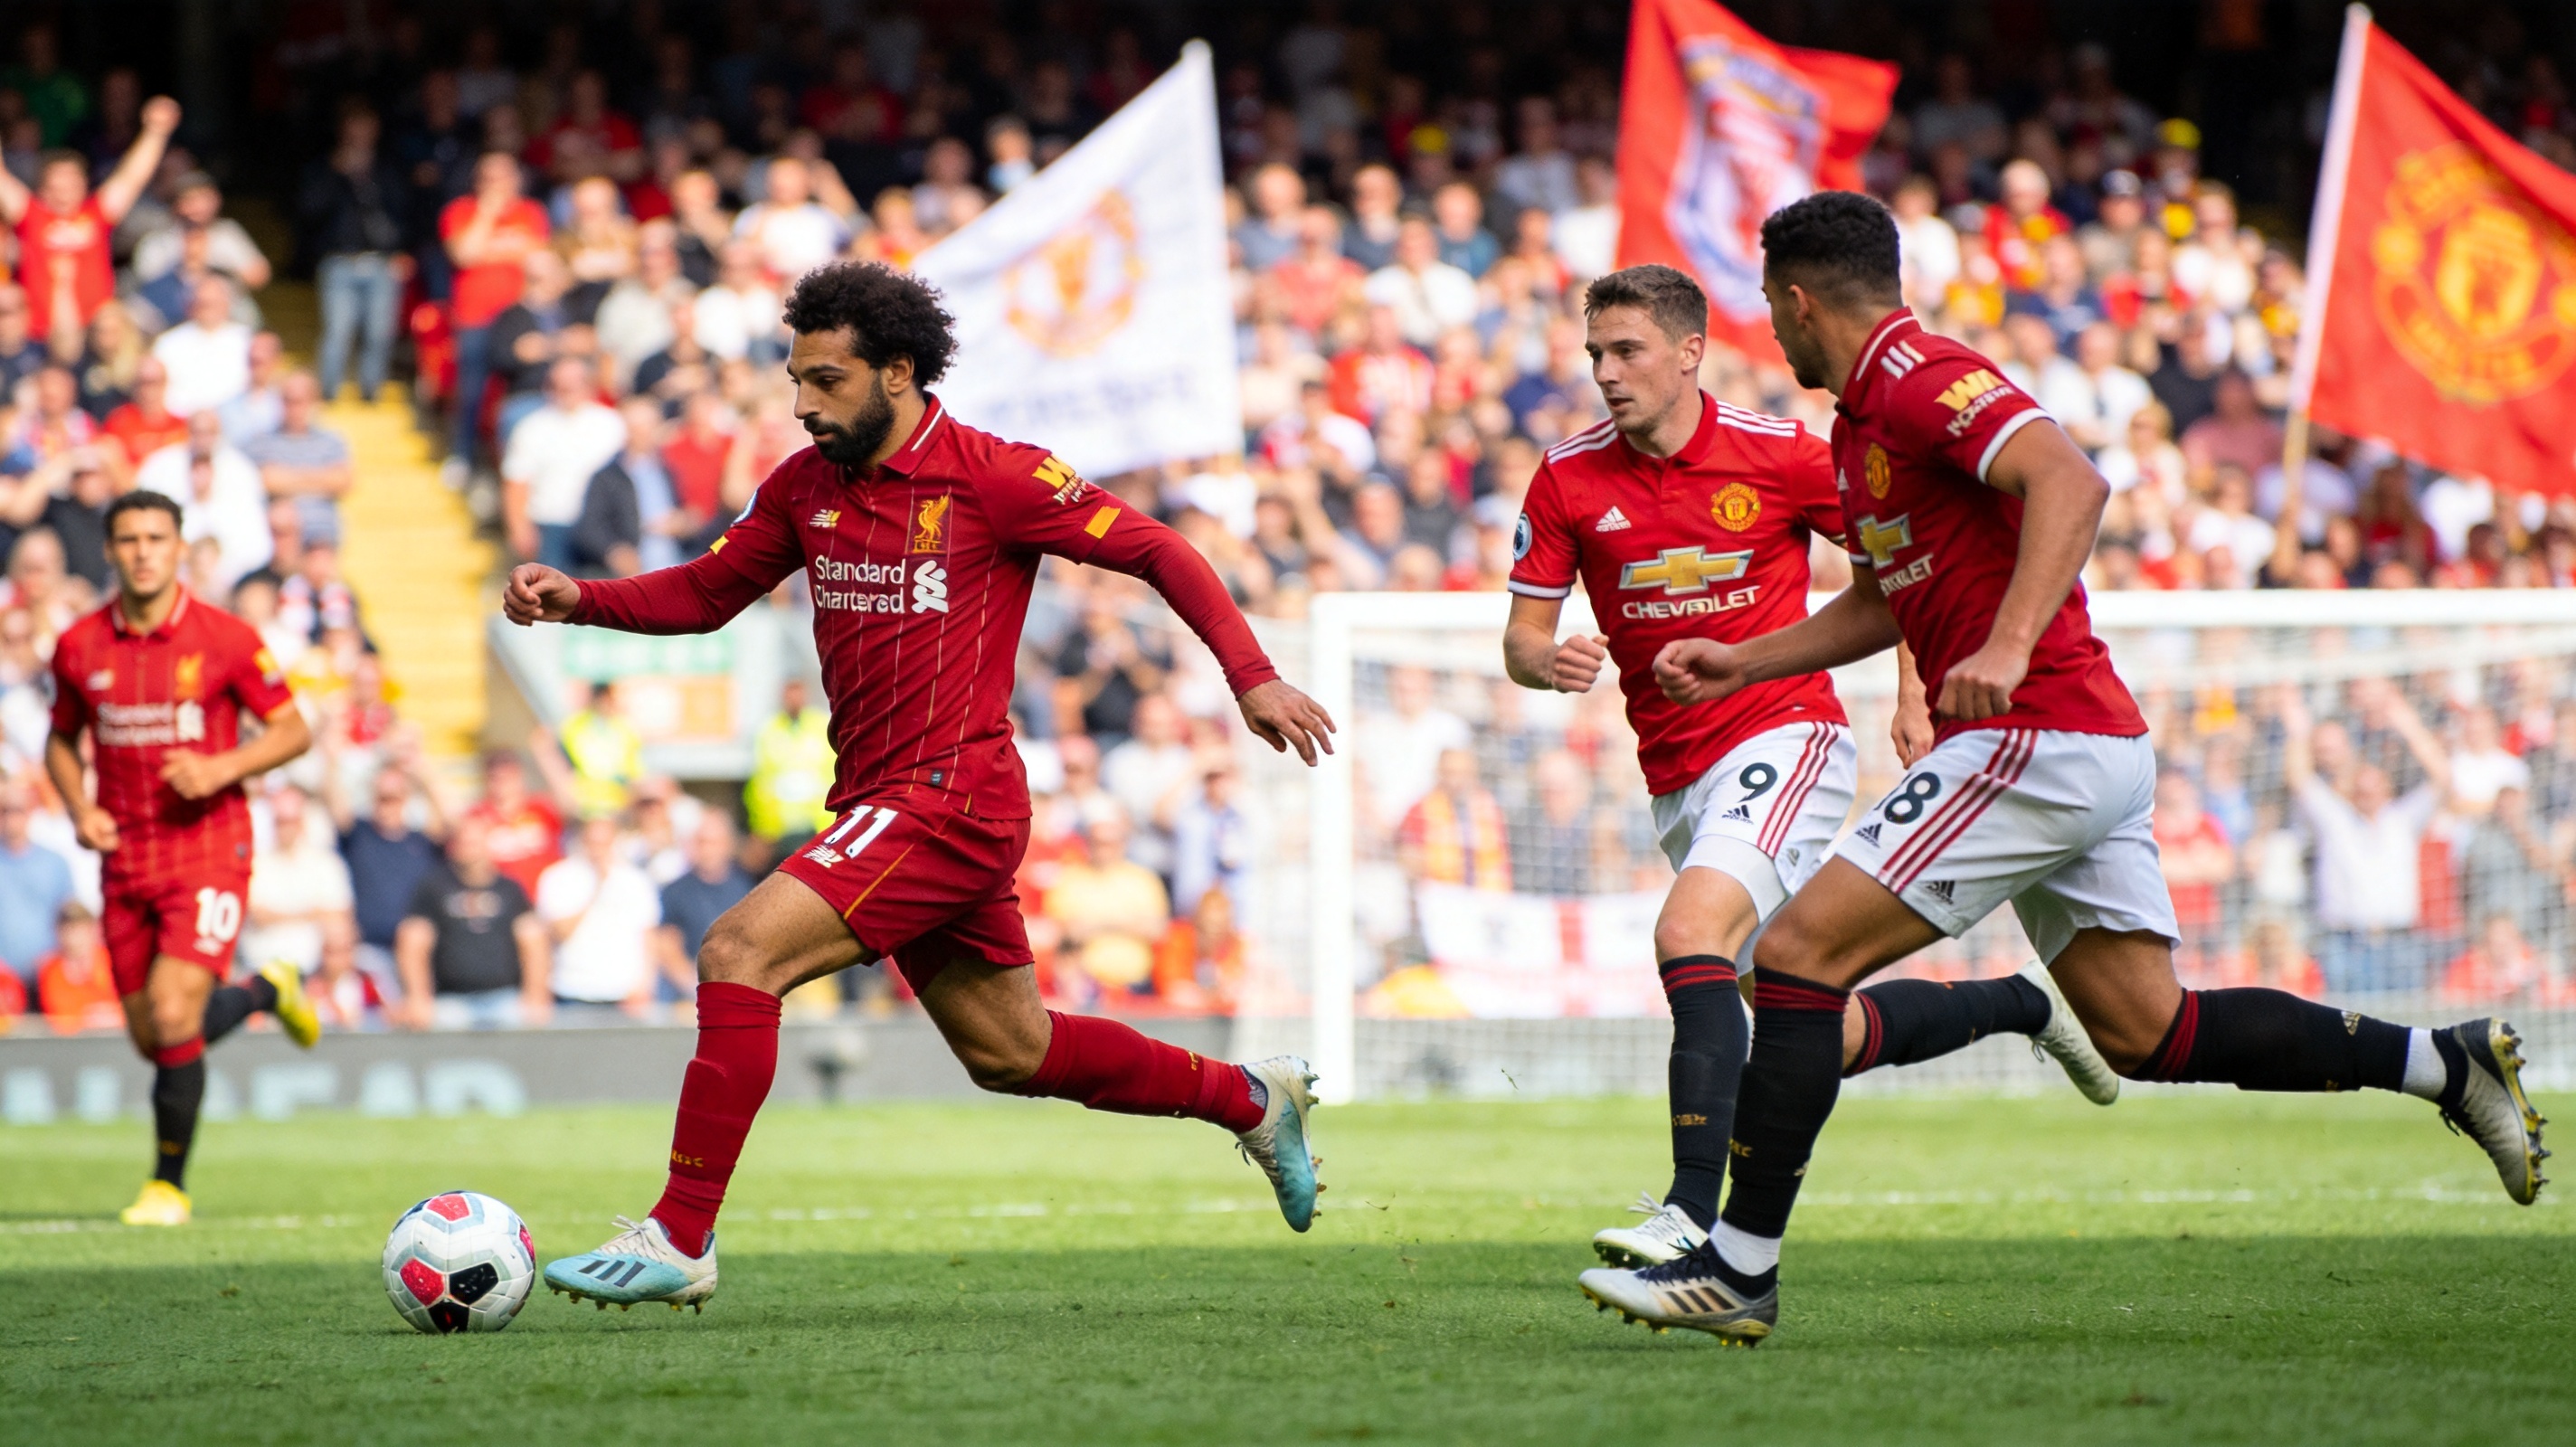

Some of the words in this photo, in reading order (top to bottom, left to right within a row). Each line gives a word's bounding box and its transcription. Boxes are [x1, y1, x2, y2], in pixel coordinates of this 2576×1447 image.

[815, 554, 905, 584] Standard
[1738, 762, 1778, 803] 9
[1873, 771, 1941, 825] 8
[824, 804, 899, 859] 11
[195, 887, 241, 942] 10
